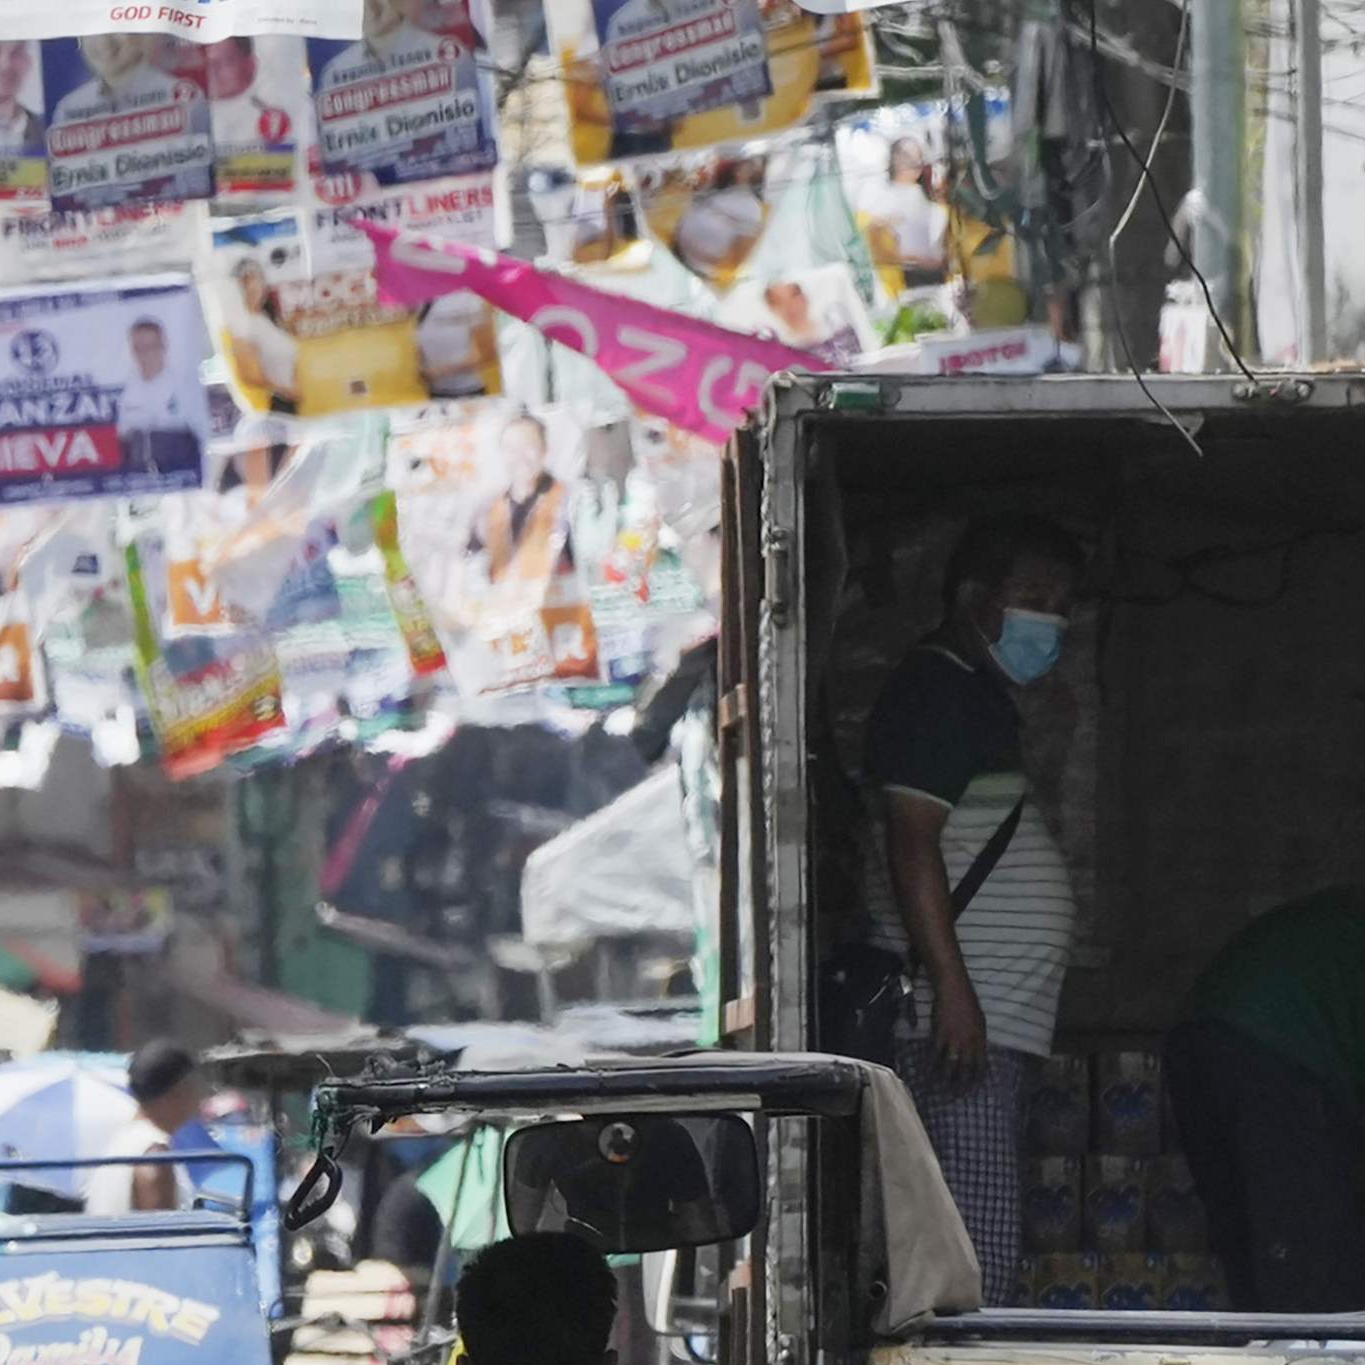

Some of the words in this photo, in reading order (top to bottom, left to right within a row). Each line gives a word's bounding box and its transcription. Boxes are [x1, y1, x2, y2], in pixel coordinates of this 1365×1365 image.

[109, 6, 152, 21] GOD
[156, 6, 207, 29] FIRST
[320, 70, 452, 116] Congressman
[386, 98, 475, 138] Dionisio
